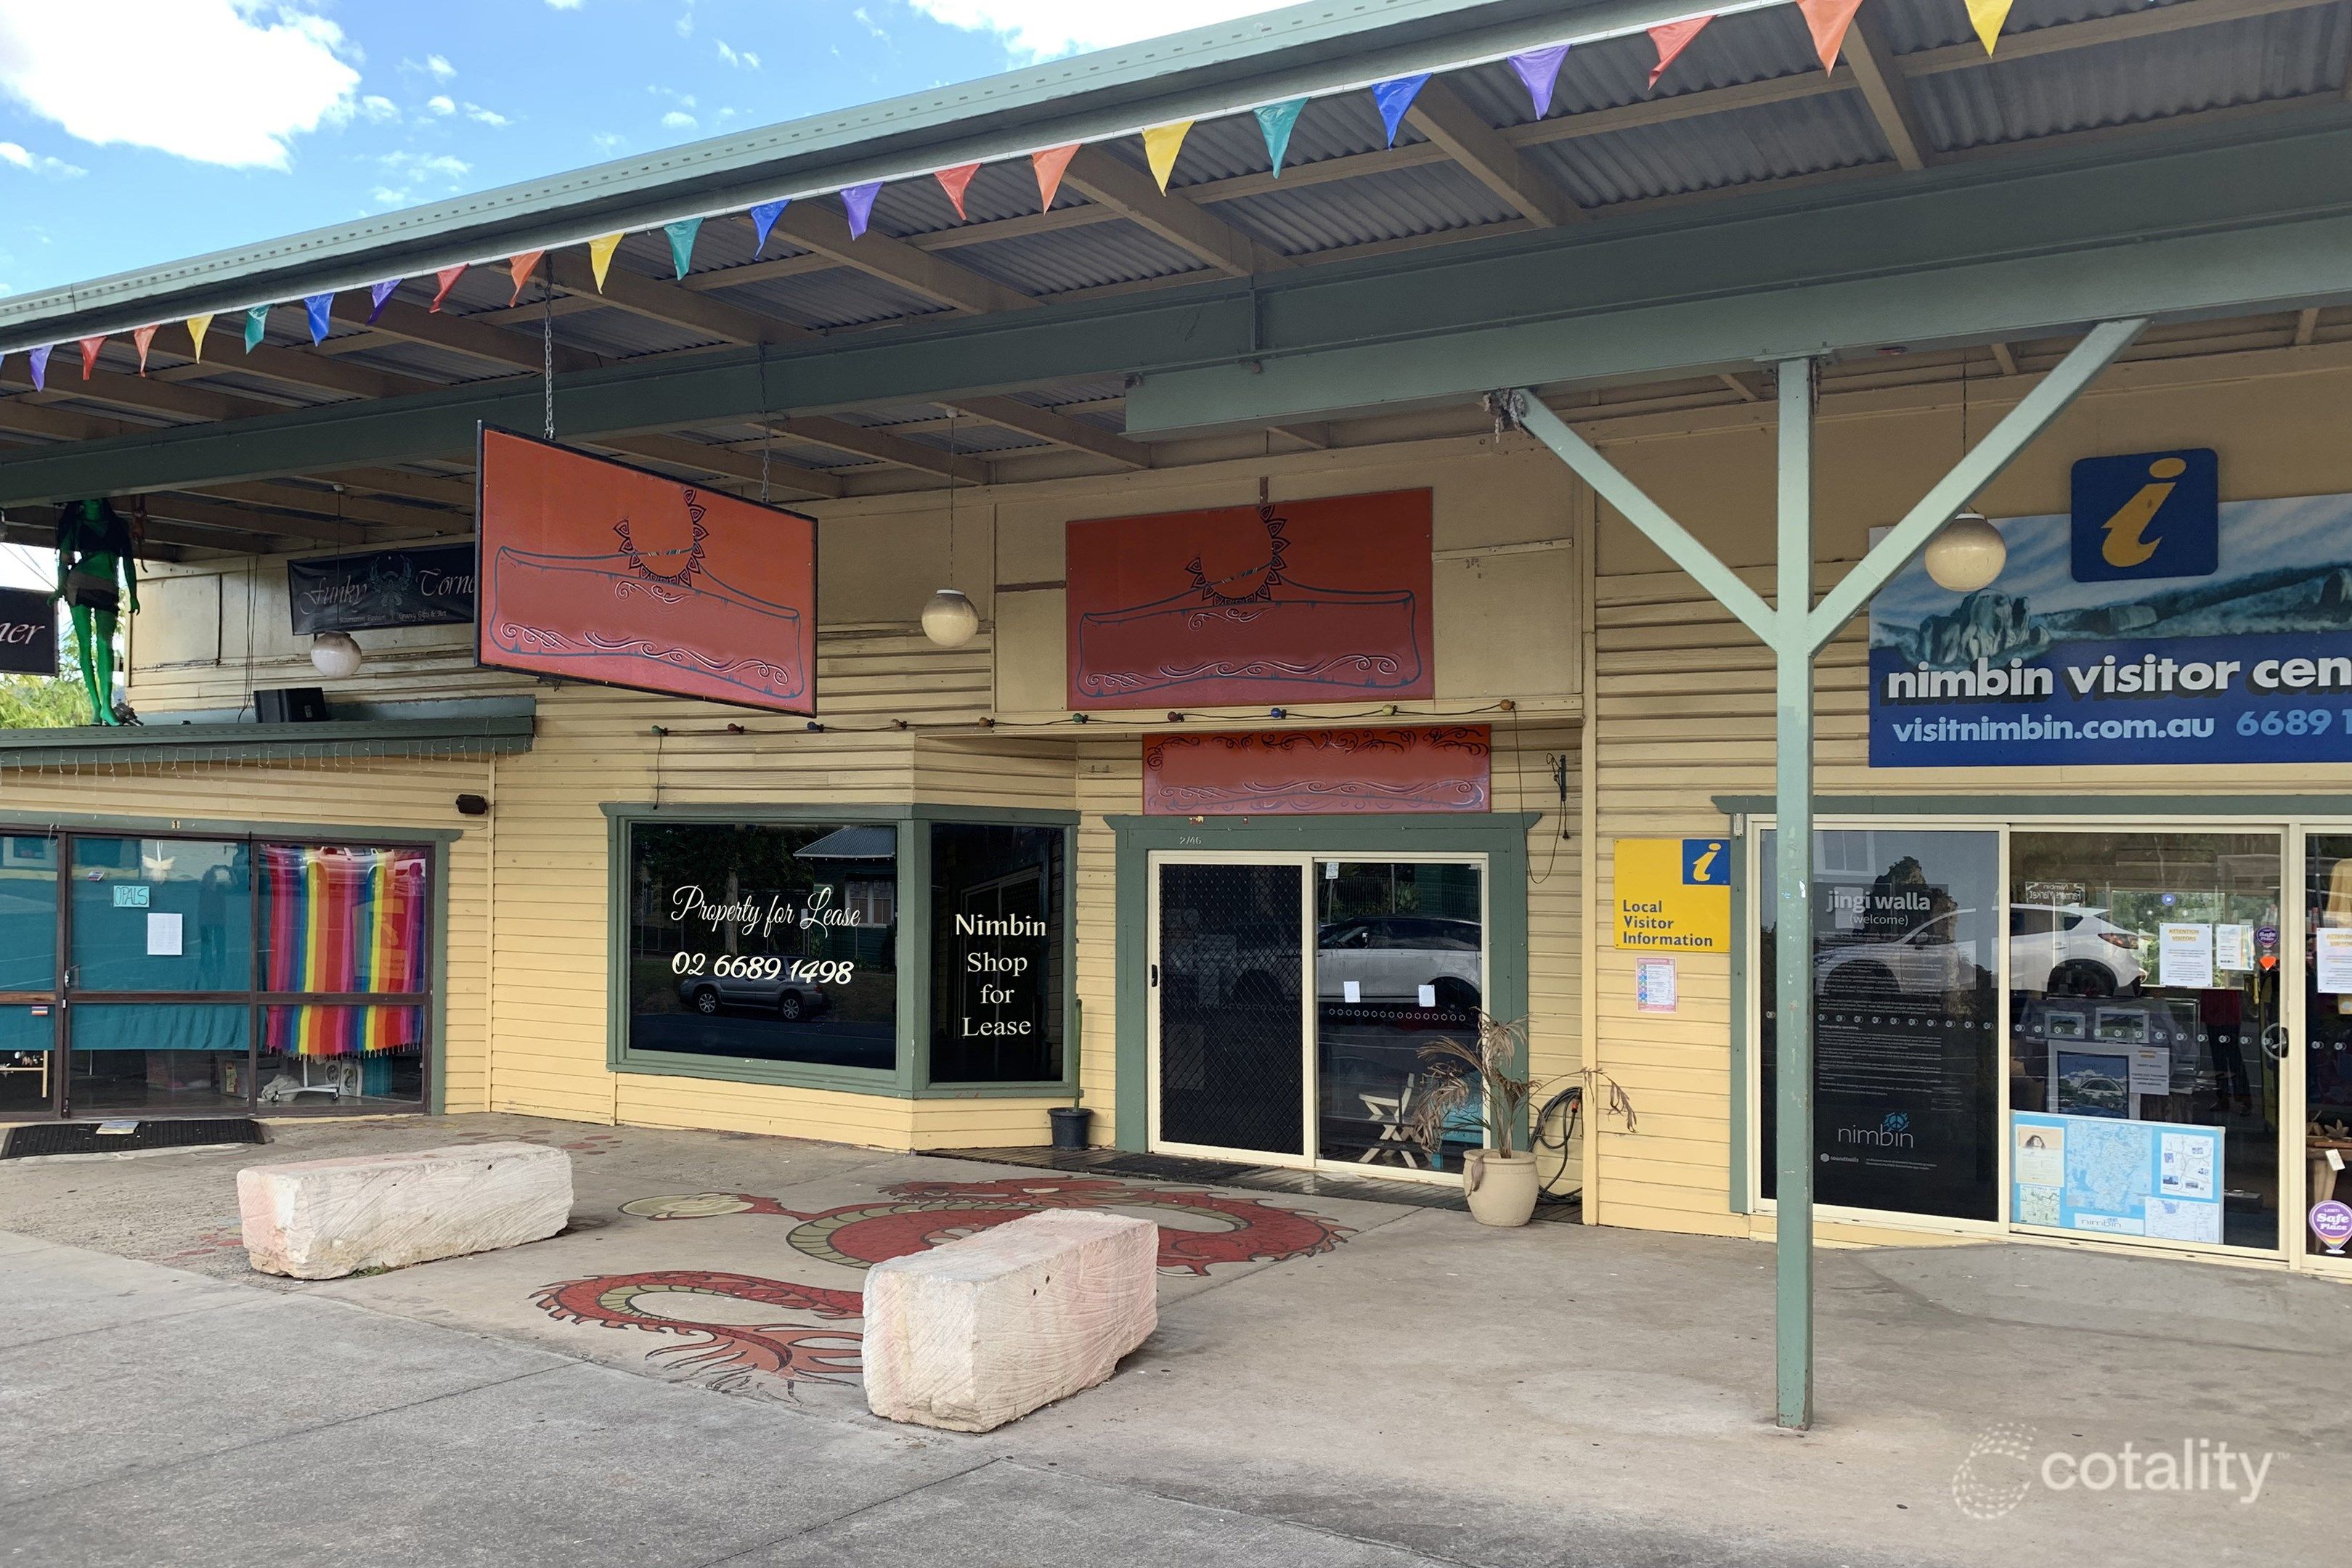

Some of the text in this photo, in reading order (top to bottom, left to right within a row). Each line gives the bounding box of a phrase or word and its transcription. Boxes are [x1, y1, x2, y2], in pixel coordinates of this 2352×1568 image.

[300, 575, 367, 615] Funky
[1888, 657, 2054, 699] nimbin
[2067, 654, 2240, 693] visitor
[1892, 714, 2215, 743] visitnimbin.com.au
[2236, 709, 2331, 737] 6689
[115, 886, 148, 906] OPALS
[1623, 900, 1662, 913] Local
[1826, 890, 1931, 912] jingi walla
[671, 883, 860, 938] Property for Lease
[1849, 913, 1909, 927] (welcome)
[955, 913, 1046, 936] Nimbin
[1624, 915, 1674, 930] Visitor
[1623, 931, 1713, 947] Information
[672, 951, 854, 984] 02 6689 1498
[967, 952, 1028, 976] Shop
[980, 984, 1014, 1004] for
[961, 1017, 1031, 1037] Lease
[1839, 1124, 1913, 1148] nimbin
[2081, 1217, 2121, 1228] nimbin
[2316, 1213, 2350, 1225] Safe
